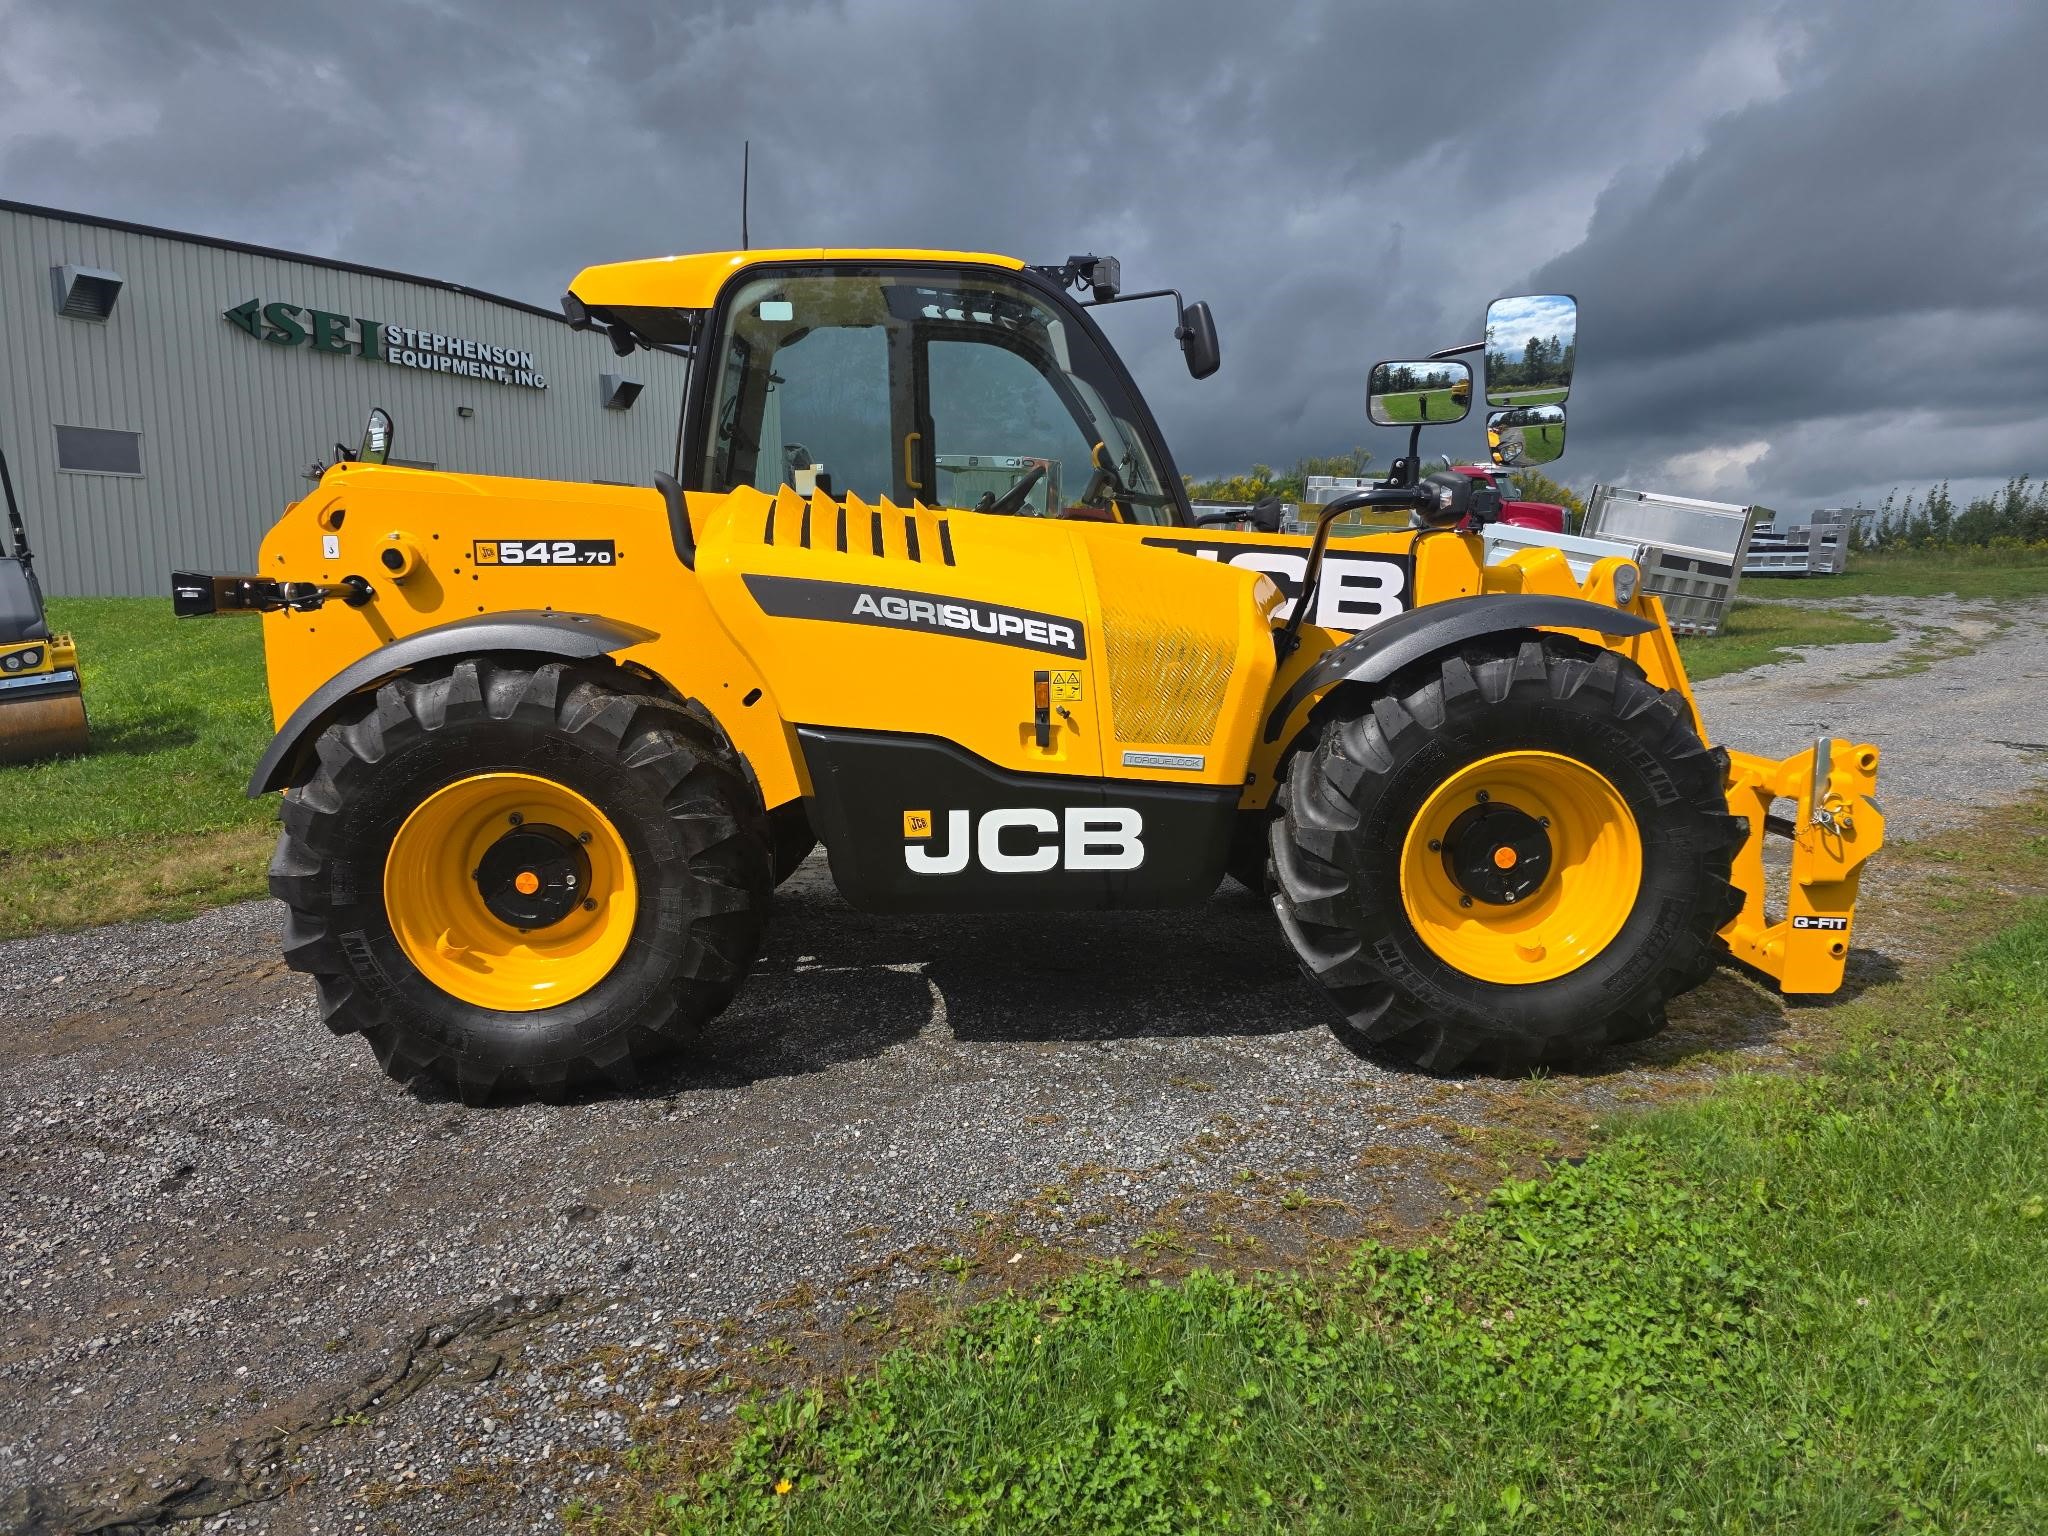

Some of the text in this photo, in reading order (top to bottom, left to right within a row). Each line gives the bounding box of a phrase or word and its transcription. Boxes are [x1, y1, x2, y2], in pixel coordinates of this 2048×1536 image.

[385, 325, 534, 370] STEPHENSON
[387, 347, 549, 389] EQUIPMENT, INC.
[1196, 550, 1405, 631] CB
[1127, 755, 1200, 767] TORQUELOCK
[904, 807, 1145, 874] JCB
[908, 815, 928, 832] JCB
[1794, 916, 1847, 930] Q-FIT
